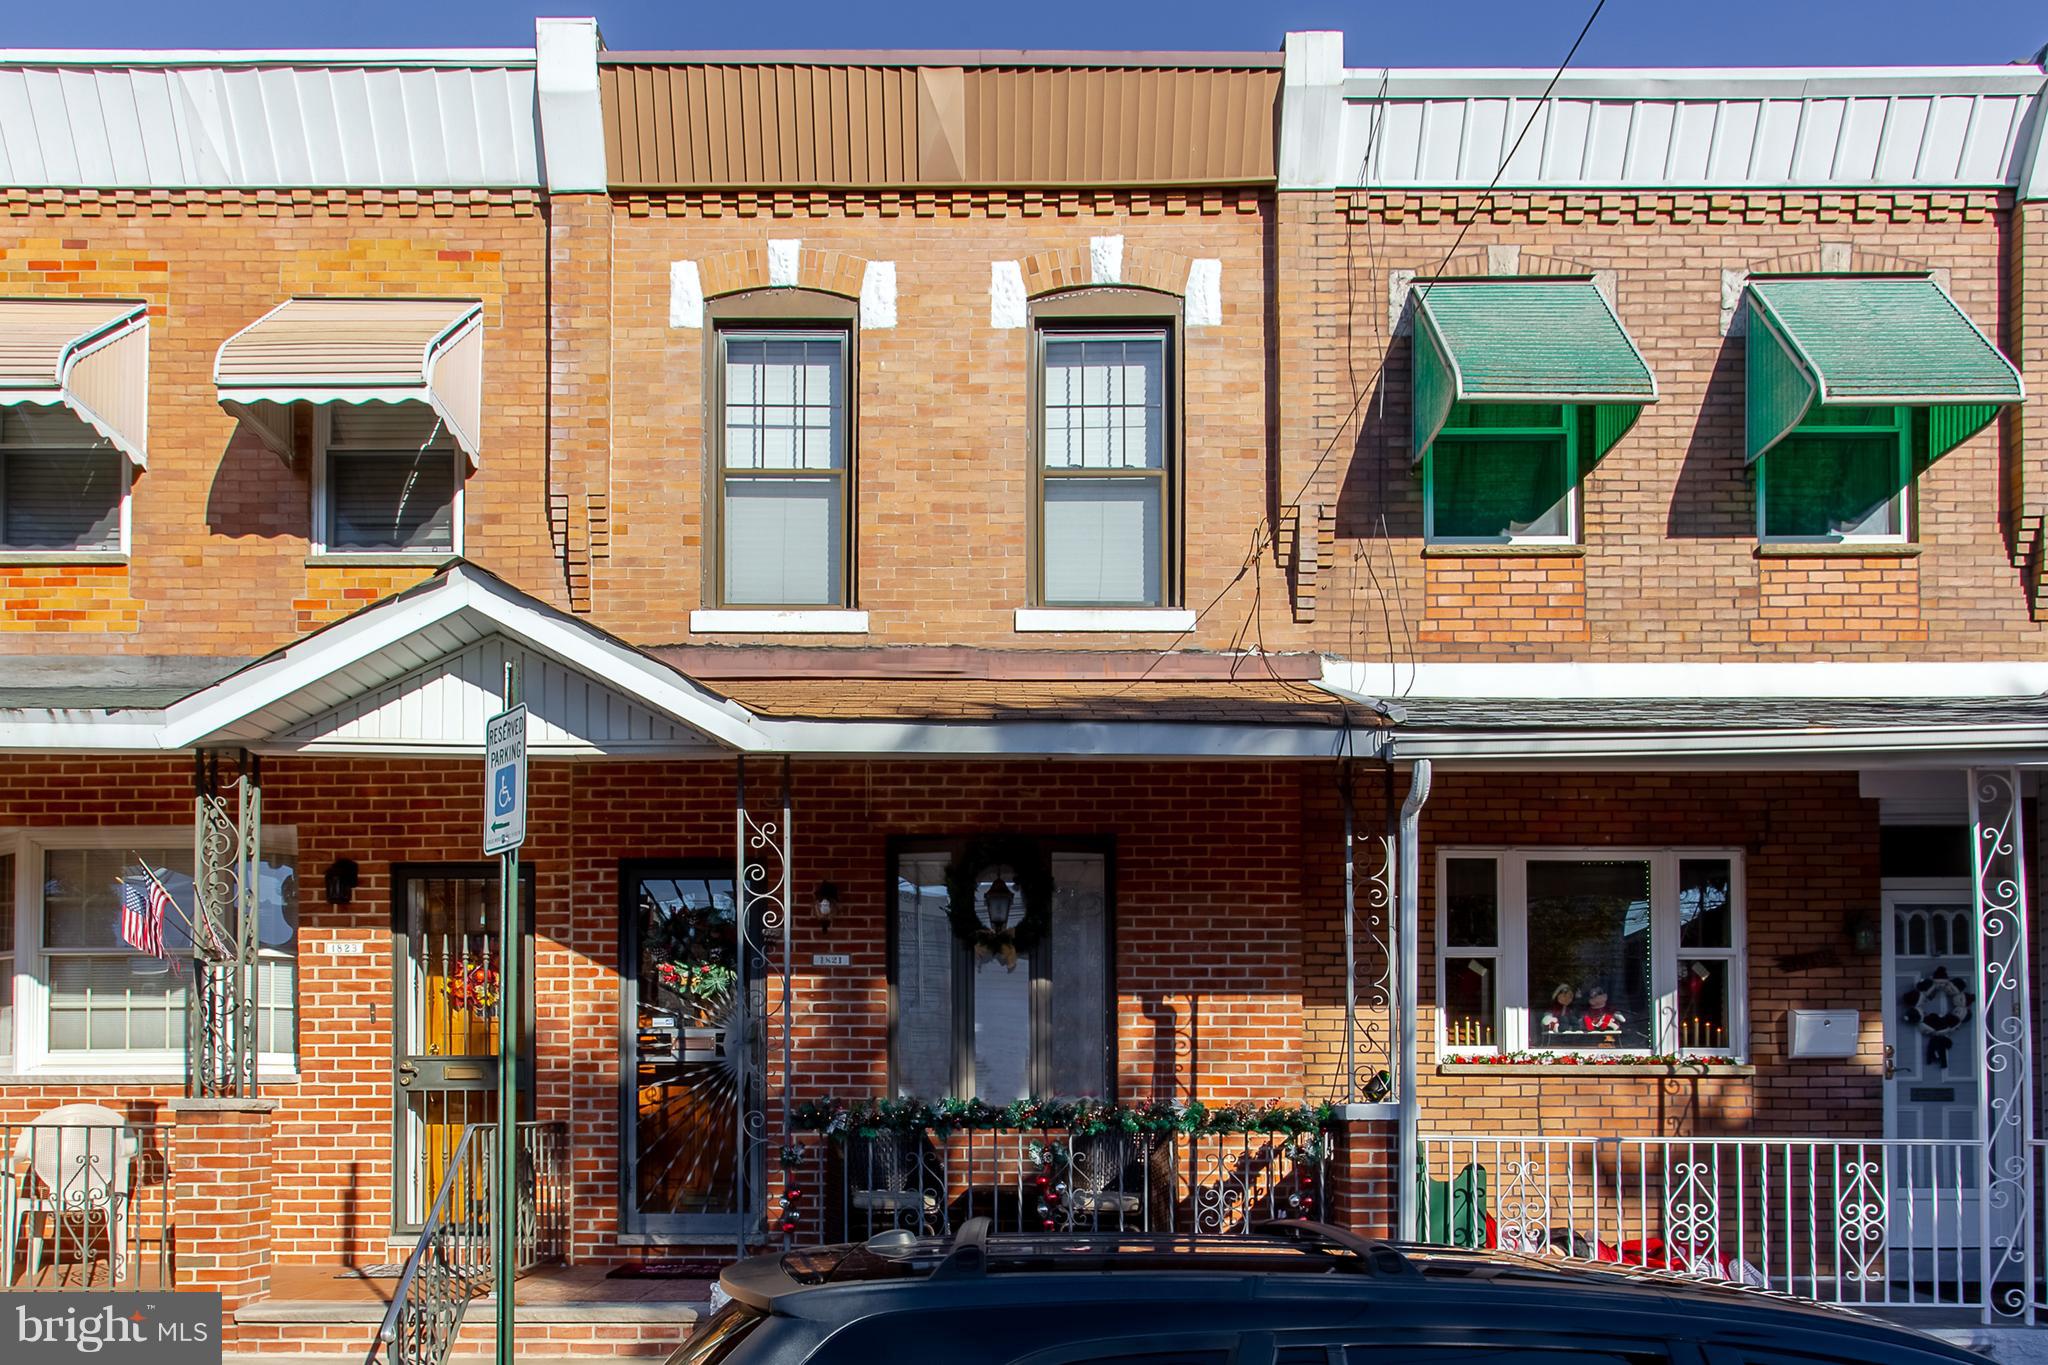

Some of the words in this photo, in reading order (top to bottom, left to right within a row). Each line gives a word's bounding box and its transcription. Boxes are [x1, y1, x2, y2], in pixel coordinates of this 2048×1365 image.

[489, 716, 524, 745] RESERVED
[490, 740, 521, 768] PARKING
[331, 943, 358, 953] 1823
[820, 956, 842, 964] 1821
